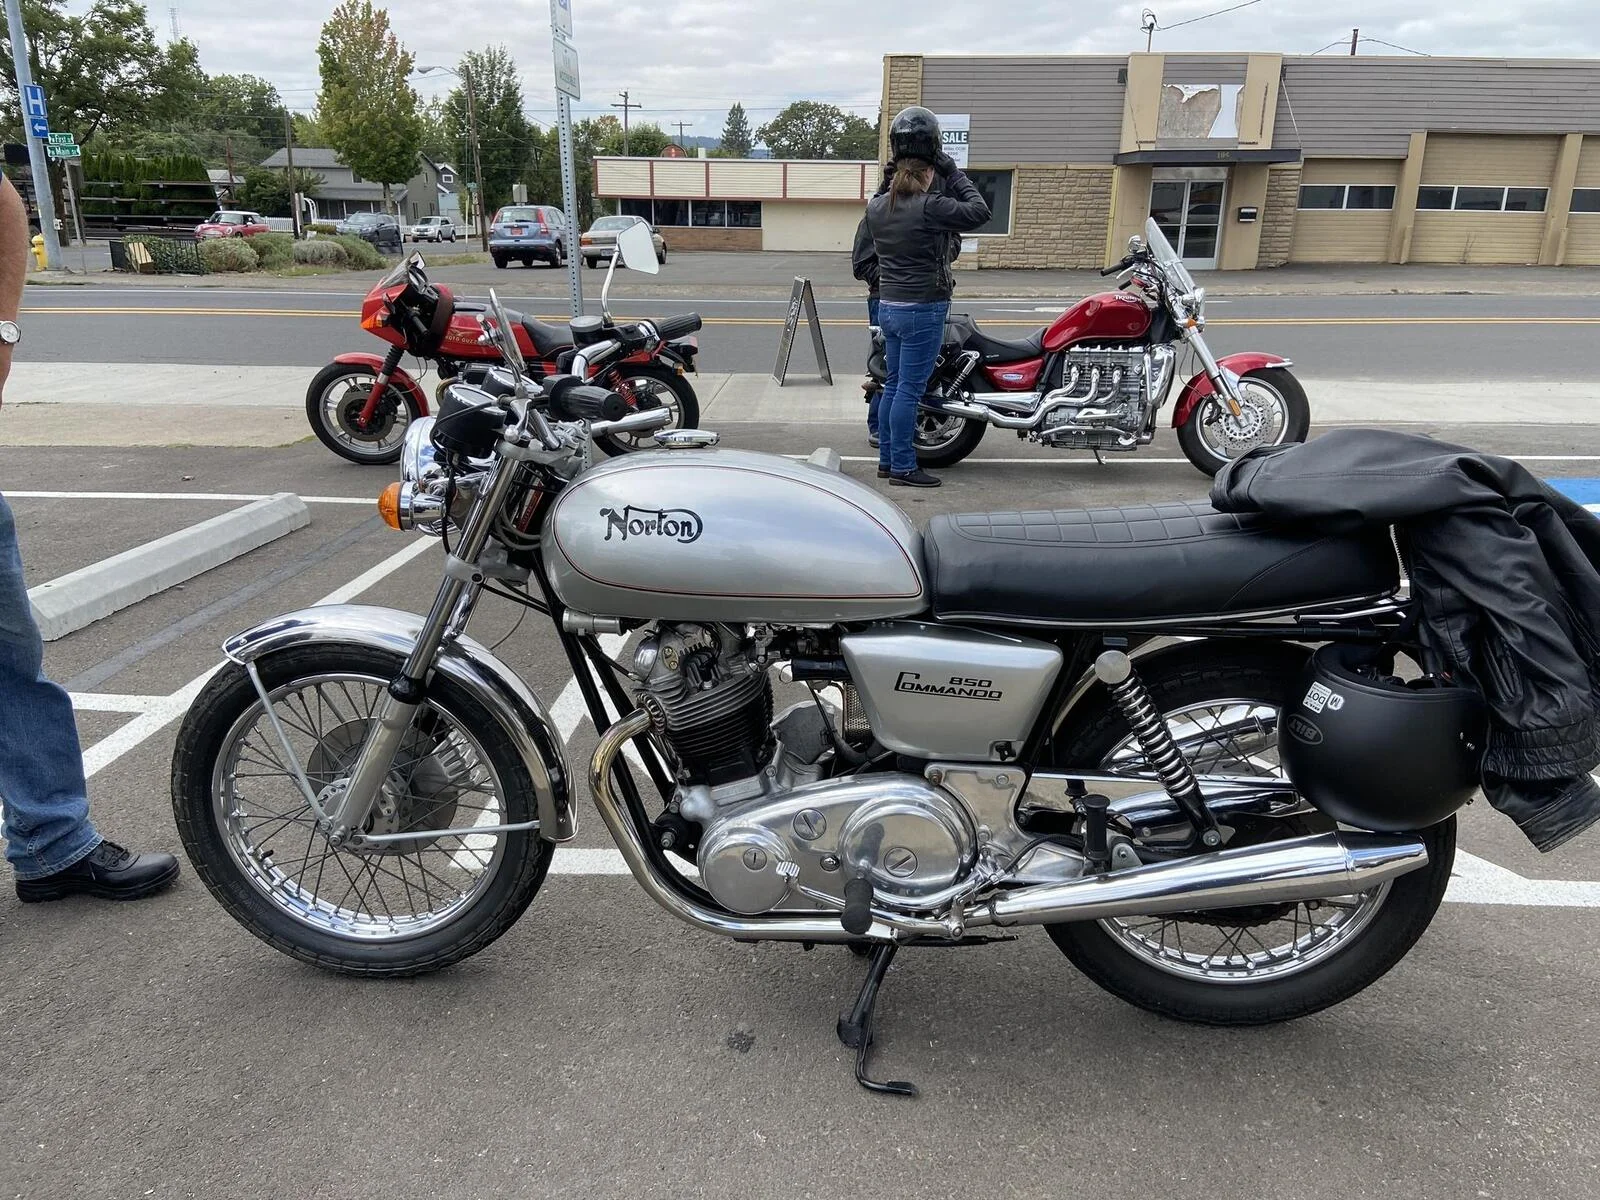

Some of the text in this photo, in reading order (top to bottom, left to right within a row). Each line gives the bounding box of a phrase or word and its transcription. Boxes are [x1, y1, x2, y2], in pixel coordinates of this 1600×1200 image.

[26, 87, 44, 115] H
[942, 132, 967, 143] SALE
[600, 504, 703, 544] Norton
[894, 671, 1003, 701] COMMANDO
[949, 676, 992, 688] 850
[1308, 690, 1326, 705] DOT
[1330, 695, 1341, 708] M
